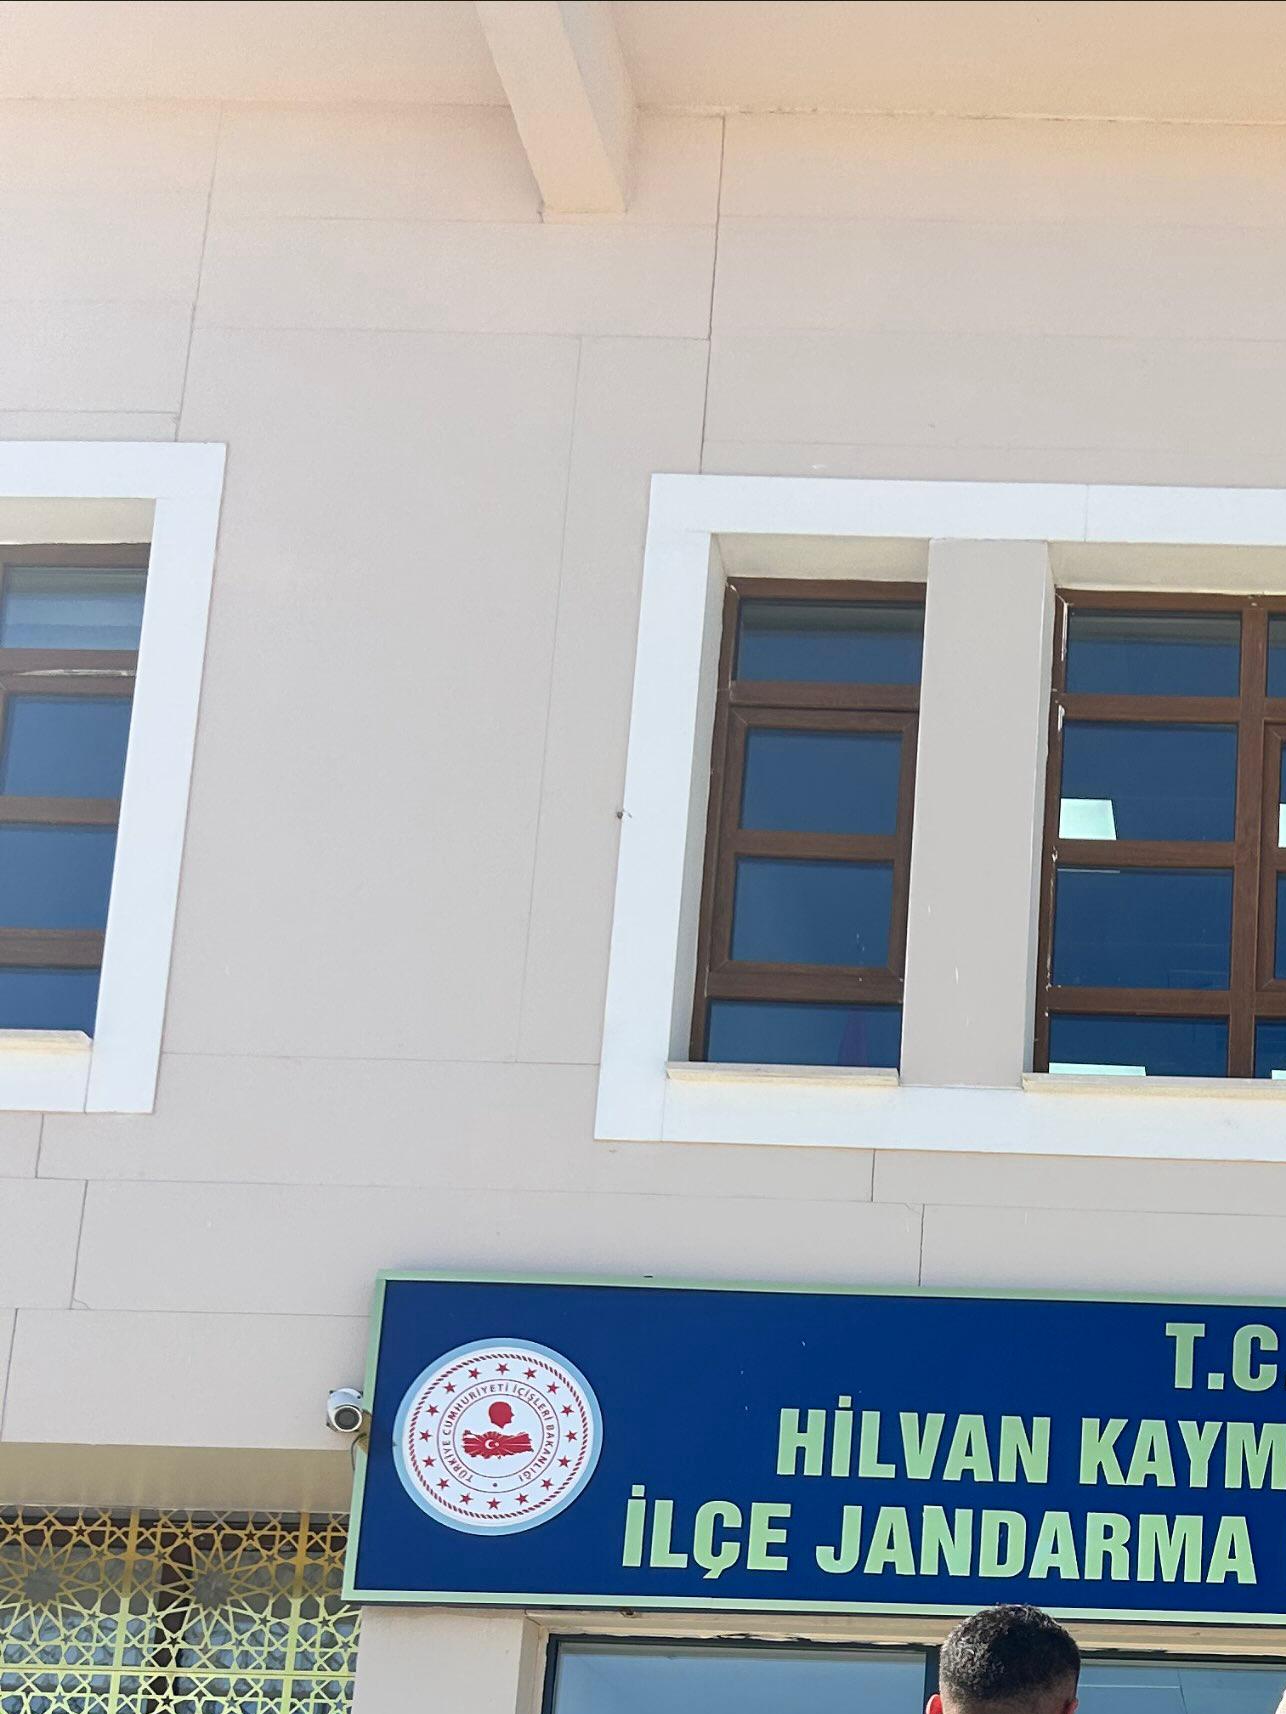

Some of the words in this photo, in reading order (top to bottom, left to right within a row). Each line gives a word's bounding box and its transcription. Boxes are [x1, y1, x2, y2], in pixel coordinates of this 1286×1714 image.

[443, 1382, 510, 1436] CUMHURİYETİ
[512, 1382, 554, 1423] İÇİŞLERİ
[442, 1440, 474, 1483] TÜRKİYE
[518, 1424, 555, 1482] BAKANLIĞI
[776, 1395, 1051, 1484] HİLVAN
[622, 1484, 792, 1580] İLÇE
[815, 1503, 1257, 1586] JANDARMA
